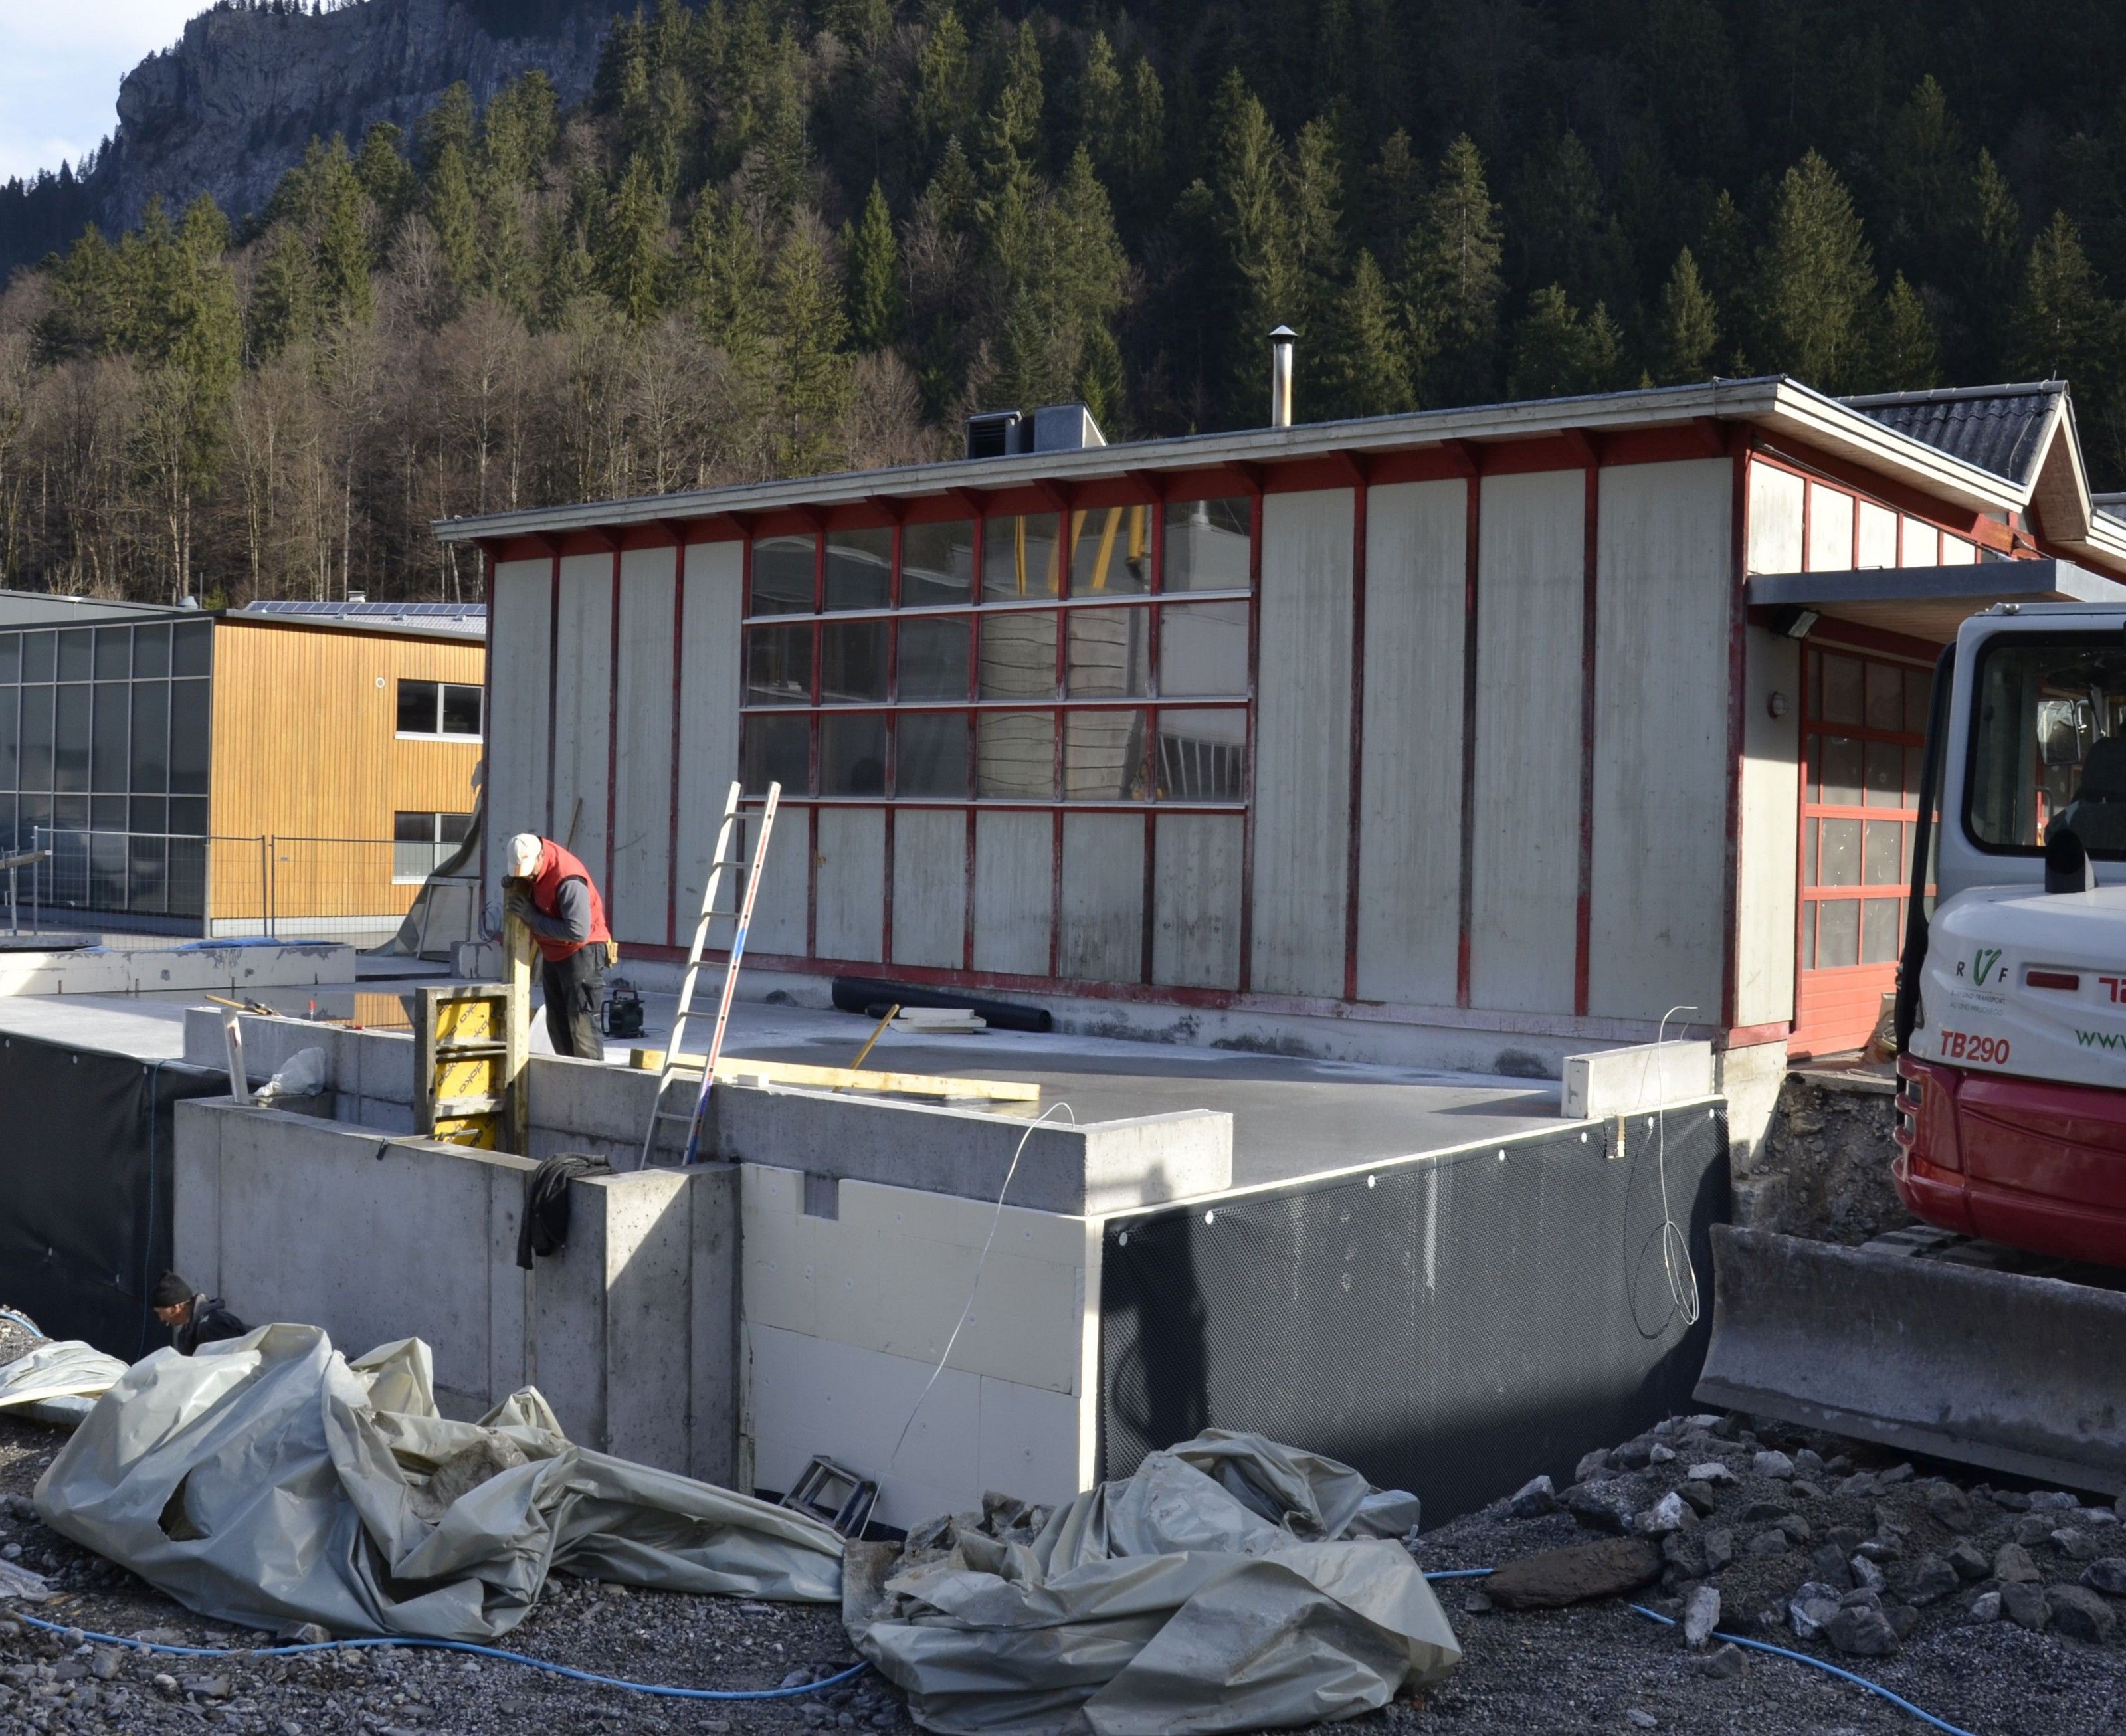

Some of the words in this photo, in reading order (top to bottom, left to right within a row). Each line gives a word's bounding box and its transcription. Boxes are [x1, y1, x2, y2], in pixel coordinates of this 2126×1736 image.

[1941, 1030, 2010, 1064] TB290
[438, 1063, 456, 1087] dok
[459, 1061, 484, 1094] doka
